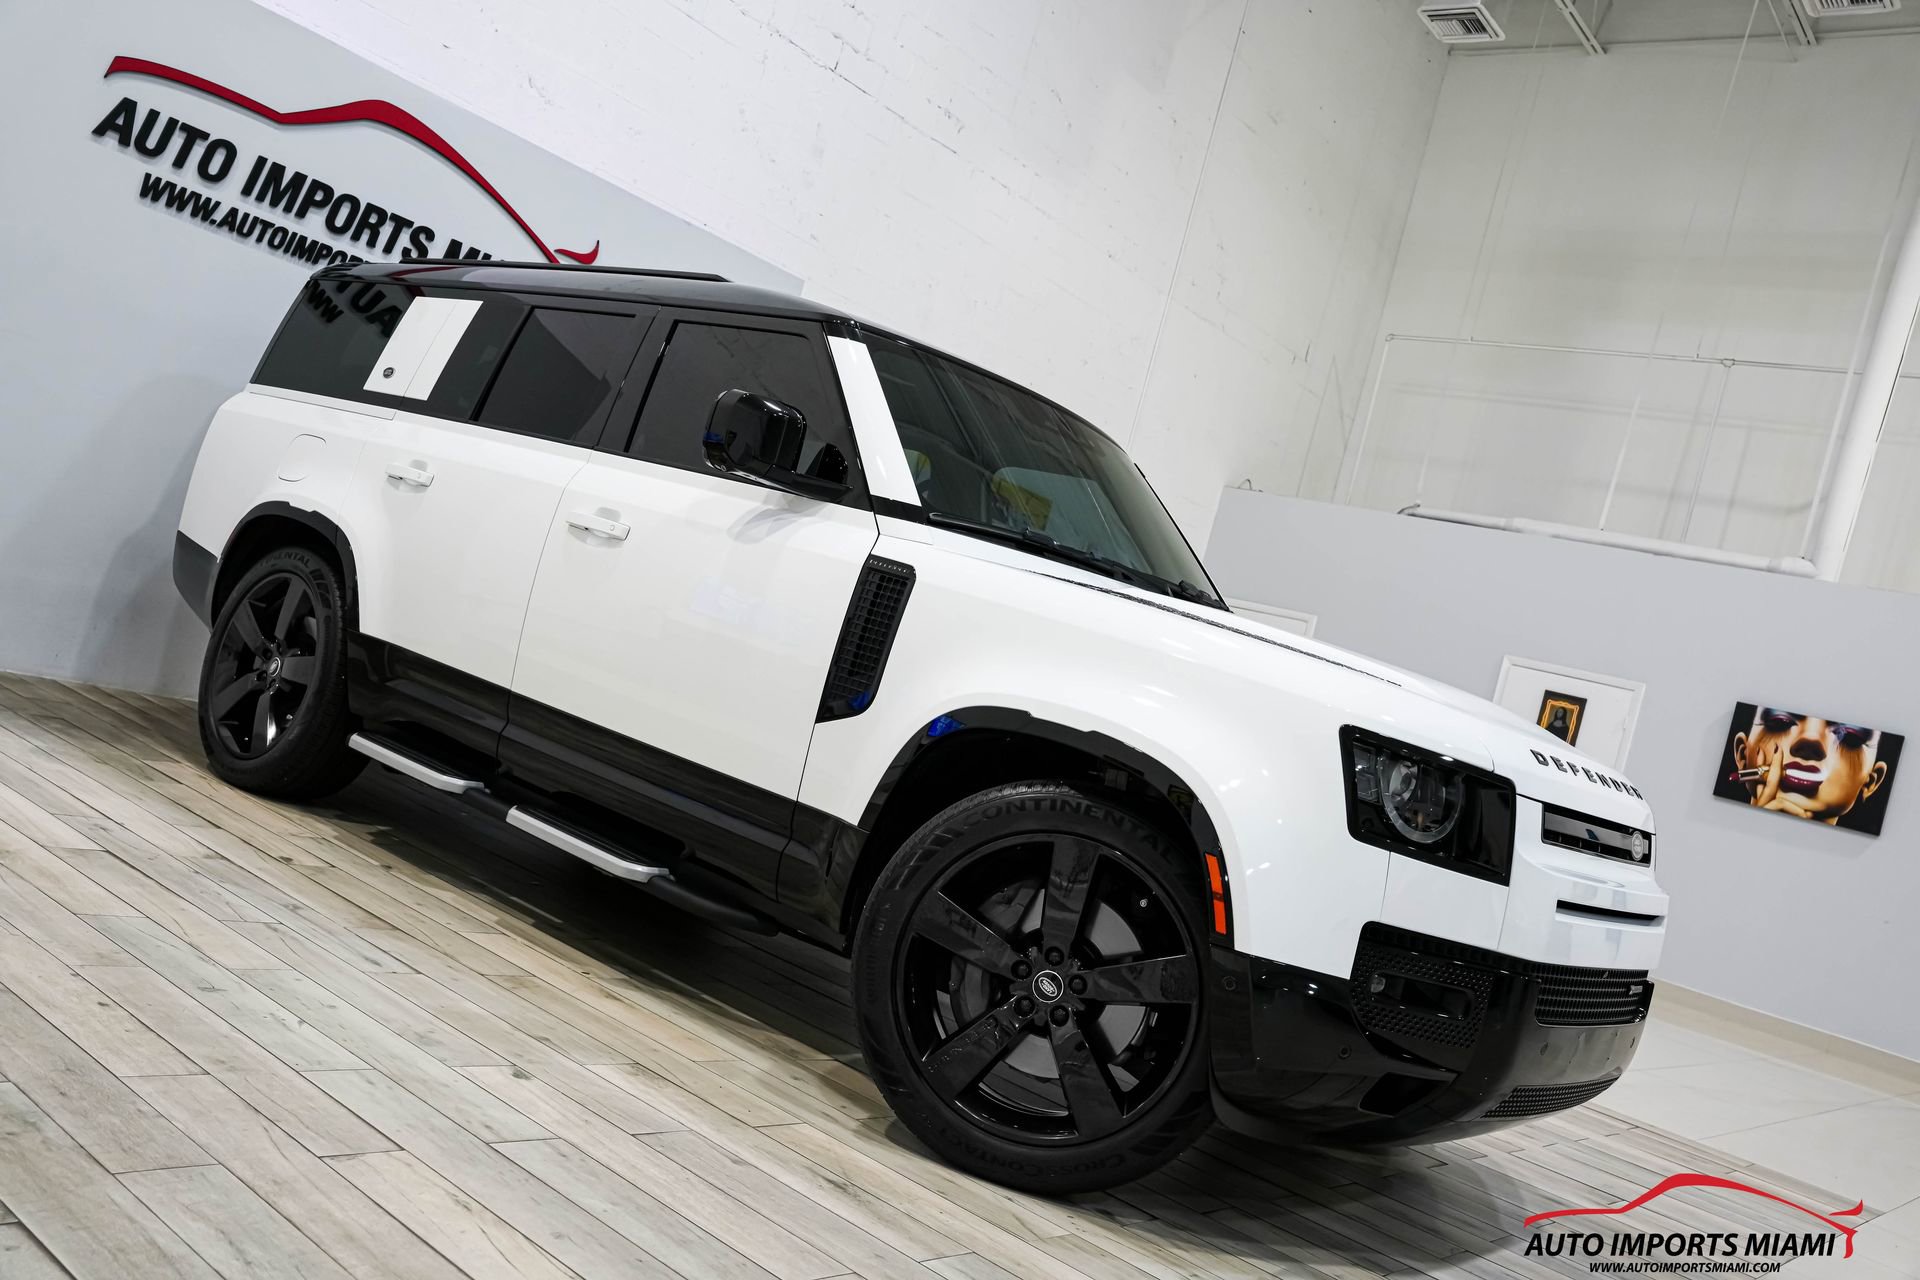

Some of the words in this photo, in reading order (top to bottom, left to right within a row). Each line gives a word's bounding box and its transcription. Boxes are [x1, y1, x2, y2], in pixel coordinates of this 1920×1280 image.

[91, 97, 237, 183] AUTO
[240, 155, 435, 259] IMPORTS
[1530, 749, 1643, 800] DEFENDER
